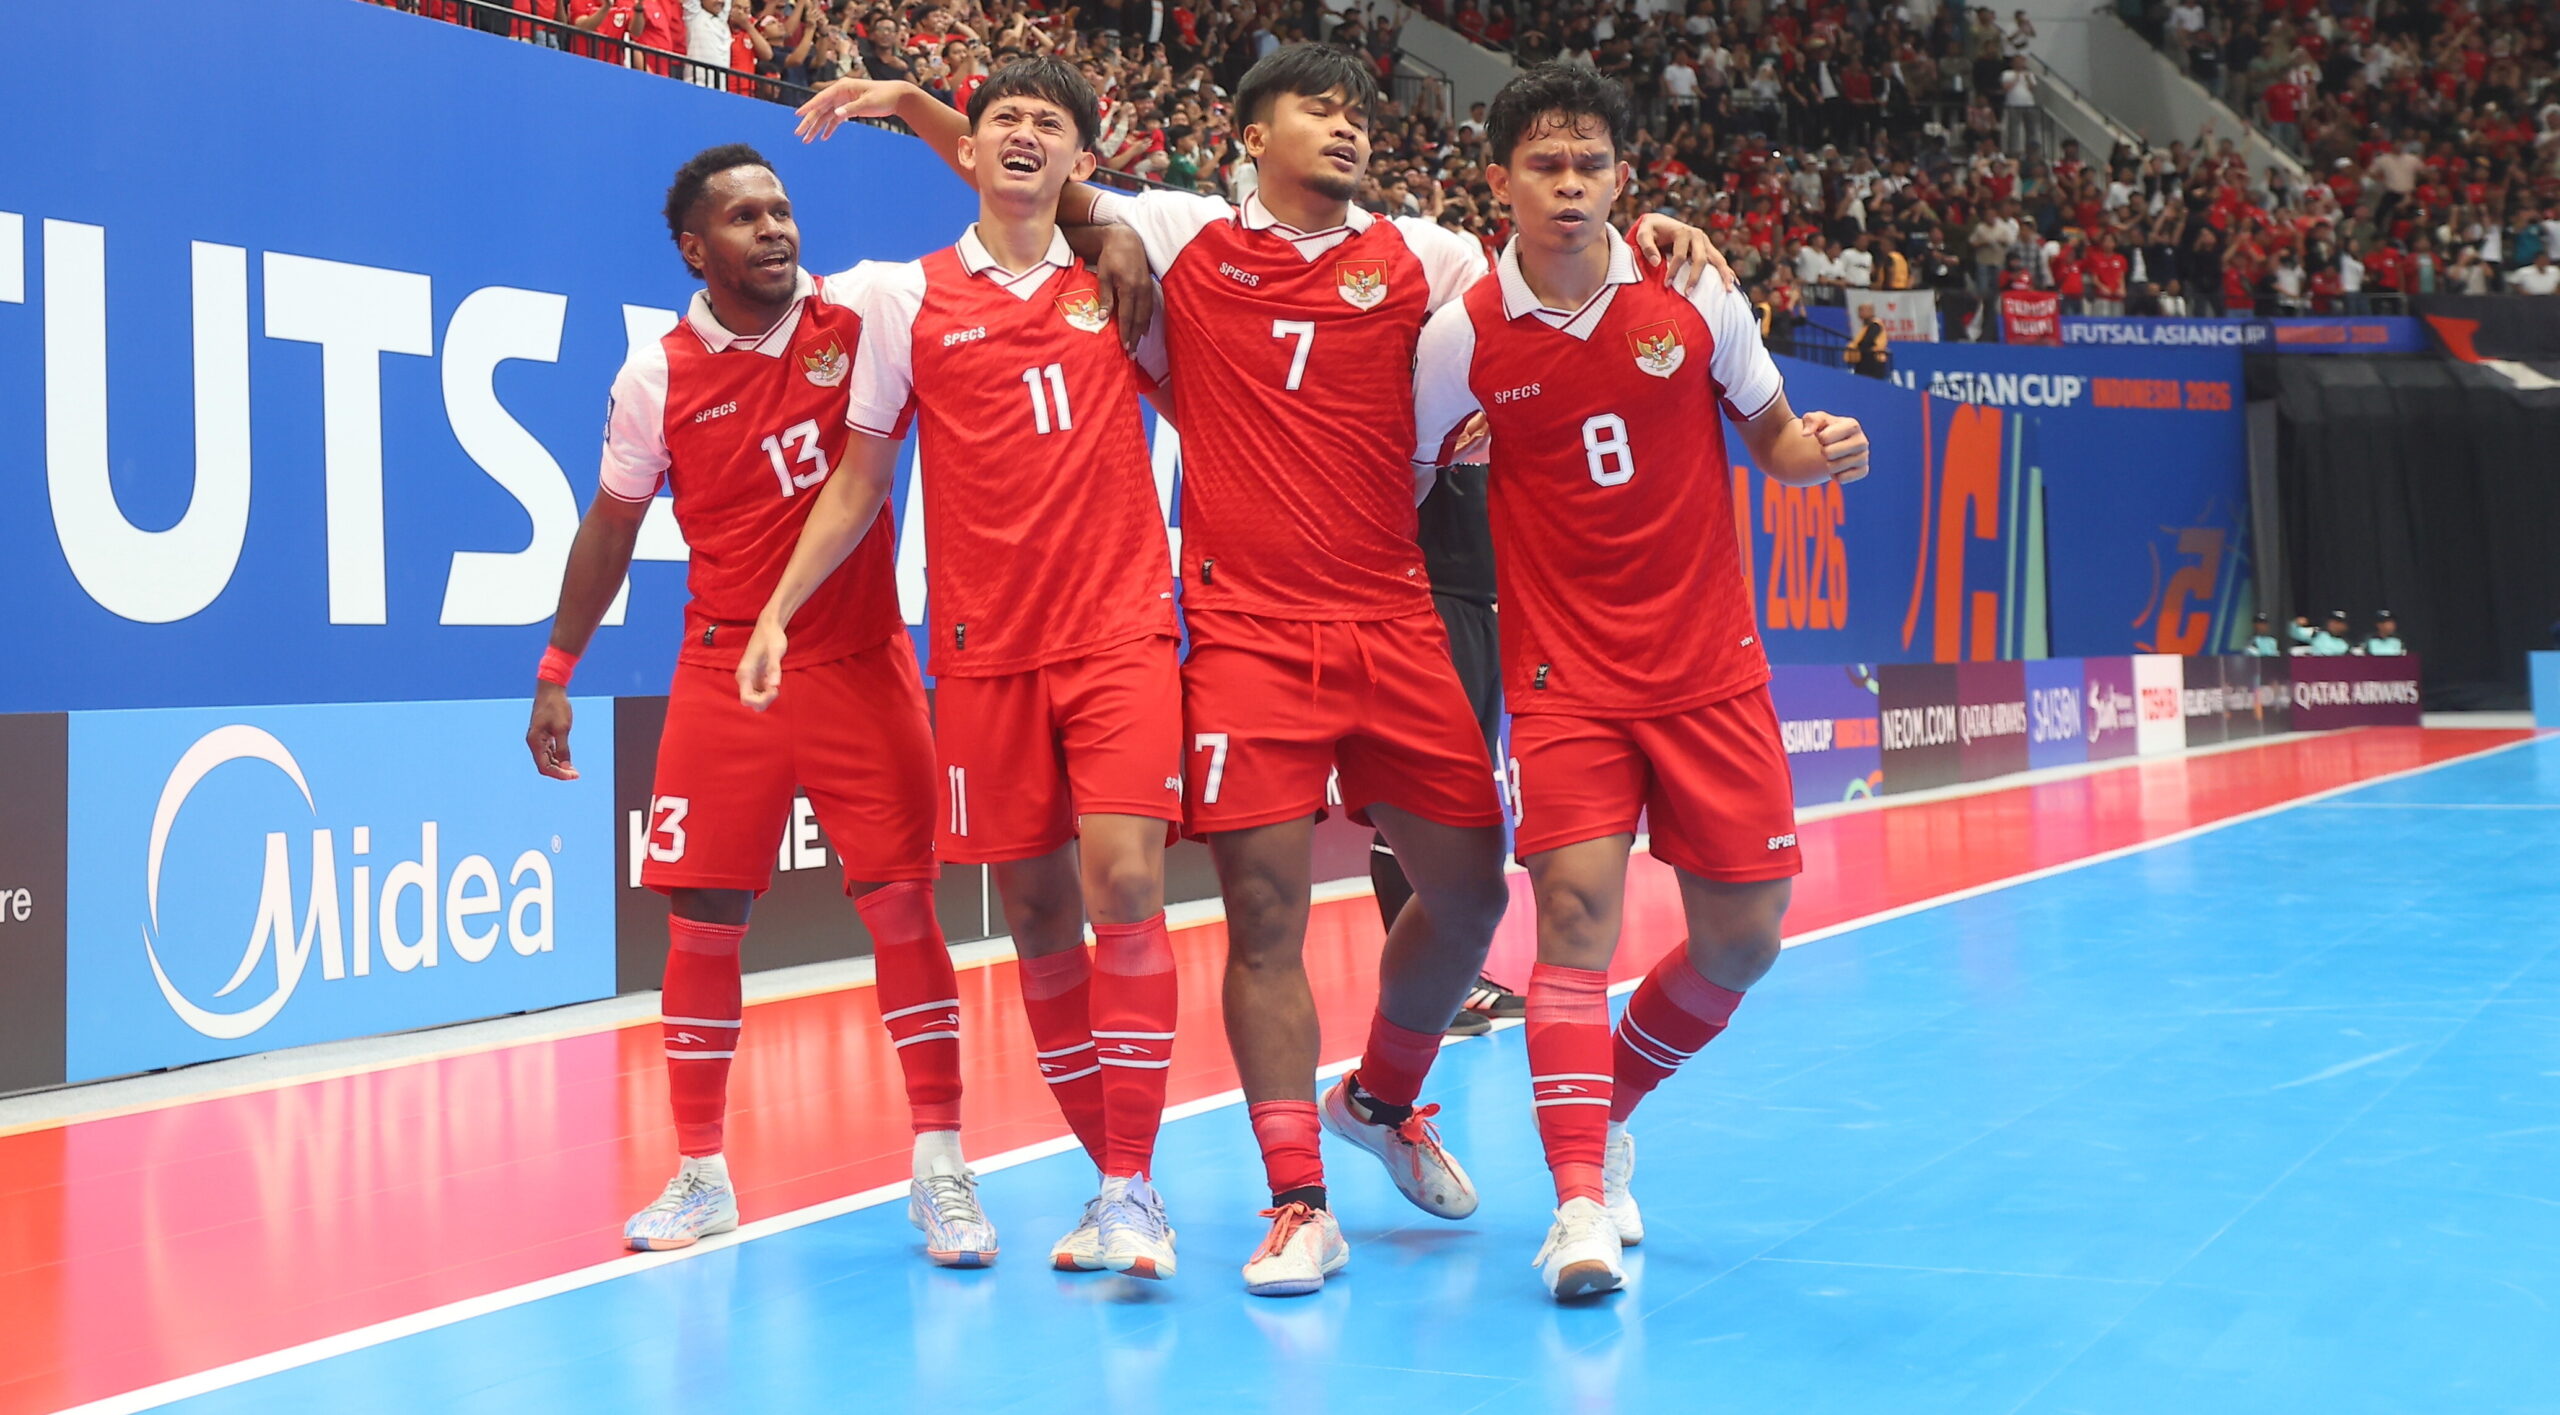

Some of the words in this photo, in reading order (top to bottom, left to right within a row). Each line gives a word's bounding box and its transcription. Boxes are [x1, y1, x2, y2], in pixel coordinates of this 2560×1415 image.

[1218, 261, 1260, 287] SPECS
[942, 326, 987, 348] SPECS
[1271, 319, 1316, 391] 7
[2071, 323, 2149, 345] FUTSAL
[694, 400, 738, 424] SPECS
[1022, 362, 1073, 435] 11
[1494, 382, 1541, 404] SPECS
[760, 418, 830, 499] 13
[1582, 412, 1635, 488] 8
[1762, 475, 1849, 631] 2026
[1959, 702, 1991, 746] QATAR
[1992, 701, 2027, 739] AIRWAYS
[2293, 681, 2350, 711] QATAR
[2351, 680, 2420, 705] AIRWAYS
[1881, 704, 1957, 751] NEOM.COM
[1194, 732, 1229, 804] 7
[948, 764, 968, 837] 11
[213, 820, 554, 998] Midea
